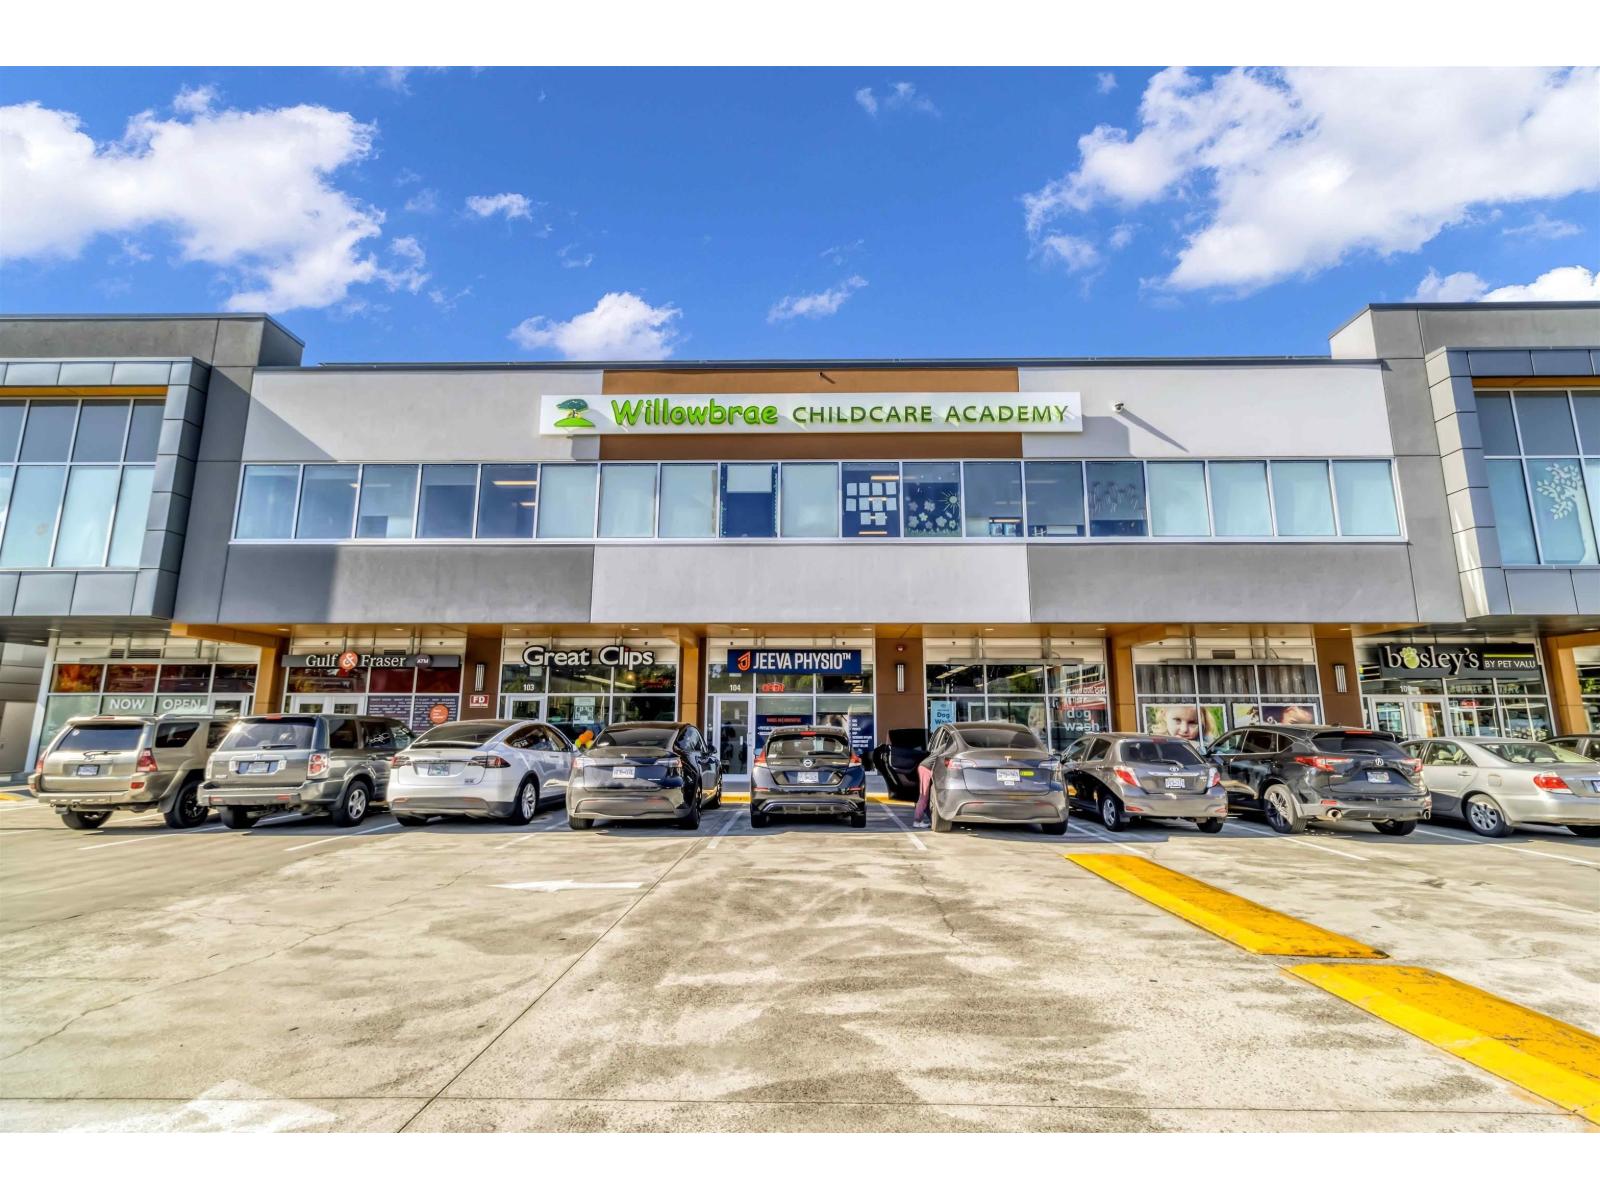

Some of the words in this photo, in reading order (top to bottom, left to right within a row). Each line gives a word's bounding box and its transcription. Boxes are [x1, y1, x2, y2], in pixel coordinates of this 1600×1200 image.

[611, 398, 778, 425] Willowbrae
[792, 406, 933, 423] CHILDCARE
[945, 405, 1068, 423] ACADEMY
[305, 654, 338, 667] Gulf
[342, 653, 356, 667] &
[360, 654, 406, 667] Fraser
[523, 646, 591, 666] Great
[600, 646, 654, 671] Clips
[753, 652, 790, 670] JEEVA
[1484, 660, 1495, 668] BY
[1498, 660, 1512, 668] PET
[1514, 660, 1536, 668] VALU
[729, 684, 741, 692] 104
[109, 699, 146, 710] NOW
[162, 699, 201, 711] OPEN
[936, 712, 950, 720] Dog
[1066, 707, 1092, 721] dog
[1064, 720, 1100, 732] wash
